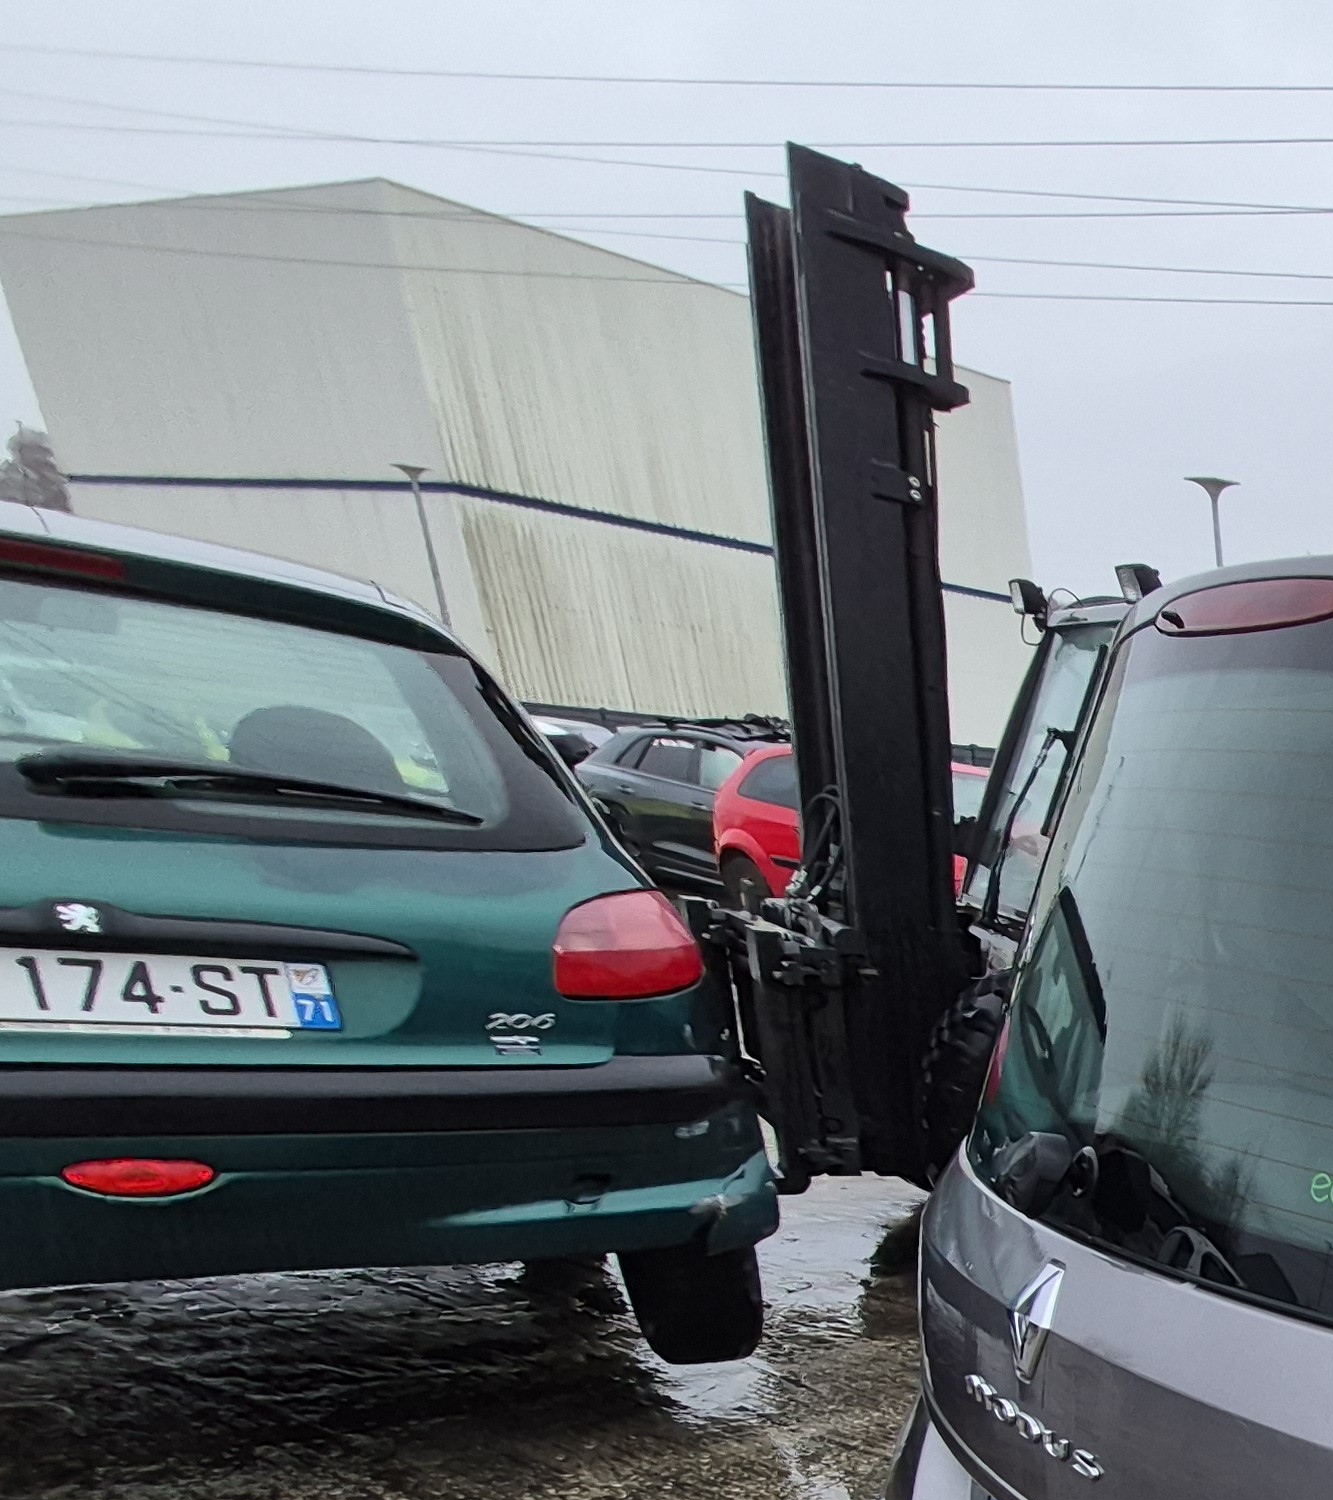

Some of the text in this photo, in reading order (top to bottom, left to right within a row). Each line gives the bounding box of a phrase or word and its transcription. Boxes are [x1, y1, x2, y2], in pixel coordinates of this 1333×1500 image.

[15, 956, 281, 1018] 174-ST
[297, 999, 336, 1024] 71
[485, 1012, 556, 1030] 206
